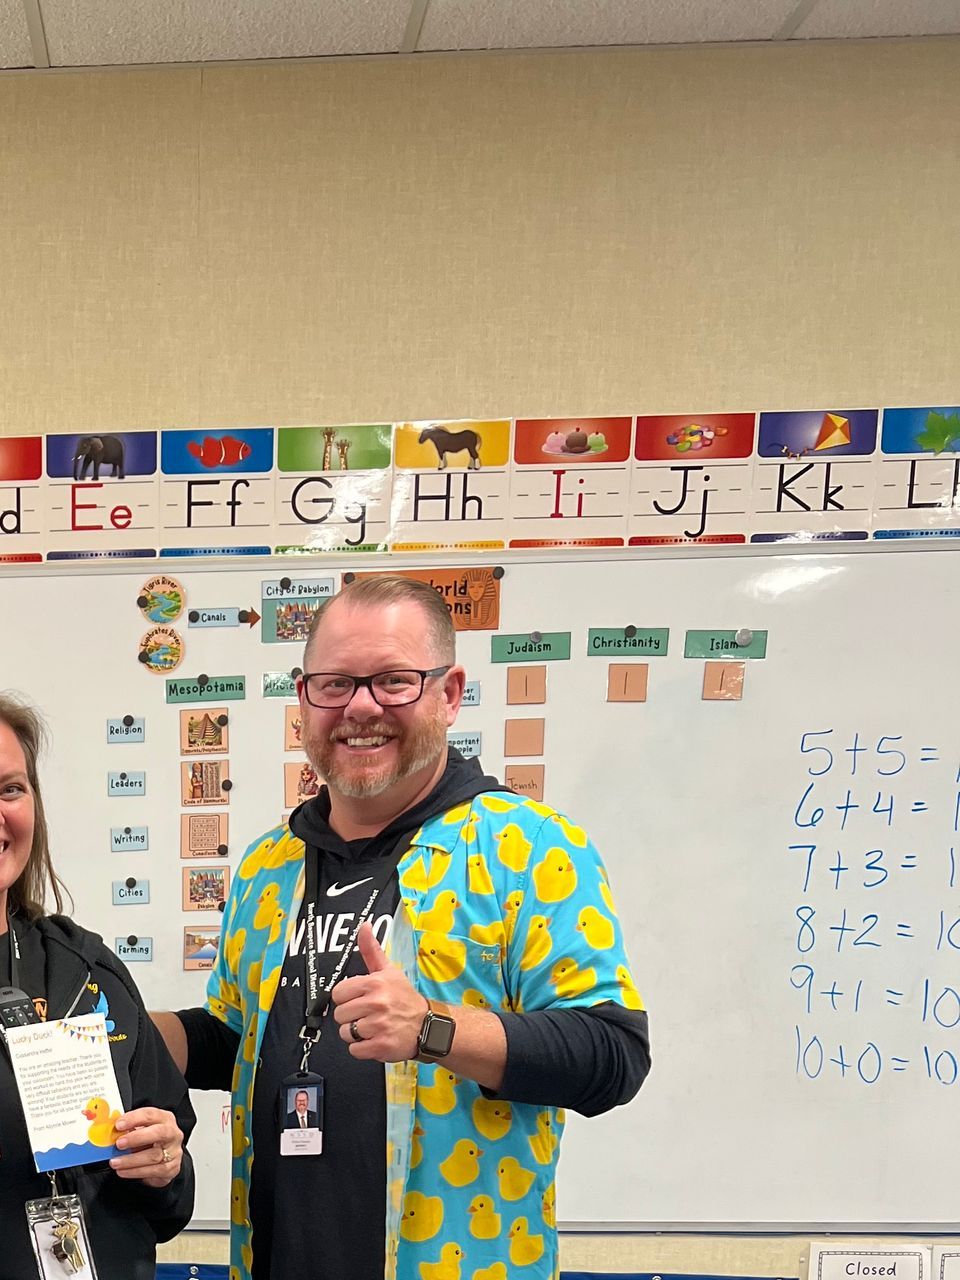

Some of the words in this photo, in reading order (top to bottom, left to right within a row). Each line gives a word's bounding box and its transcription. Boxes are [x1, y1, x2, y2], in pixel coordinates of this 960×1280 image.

[550, 469, 586, 519] Ii
[776, 462, 846, 513] Kk
[187, 479, 249, 528] Ff
[412, 472, 483, 522] Hh
[652, 465, 712, 539] Jj
[71, 483, 133, 532] Ee
[291, 476, 366, 546] Gg
[143, 579, 160, 593] Tigris
[161, 576, 178, 589] River
[266, 586, 284, 596] City
[297, 584, 330, 595] Babylon
[431, 580, 468, 596] orld
[201, 613, 226, 623] Canals
[140, 627, 169, 648] Euphrates
[168, 629, 181, 646] River
[592, 636, 661, 650] Christianity
[709, 638, 739, 651] Islam
[507, 641, 552, 655] Judaism
[168, 681, 244, 697] Mesopotamia
[109, 724, 143, 737] Religion
[448, 738, 480, 748] mportant
[110, 778, 143, 790] Leaders
[113, 832, 145, 846] Writing
[118, 887, 144, 899] Cities
[307, 902, 316, 924] North
[324, 972, 341, 992] North
[349, 917, 363, 941] School
[361, 889, 379, 916] District
[118, 944, 150, 957] Farming
[308, 949, 317, 974] School
[310, 969, 318, 1000] District
[924, 1044, 958, 1086] 10
[846, 1262, 897, 1276] Closed
